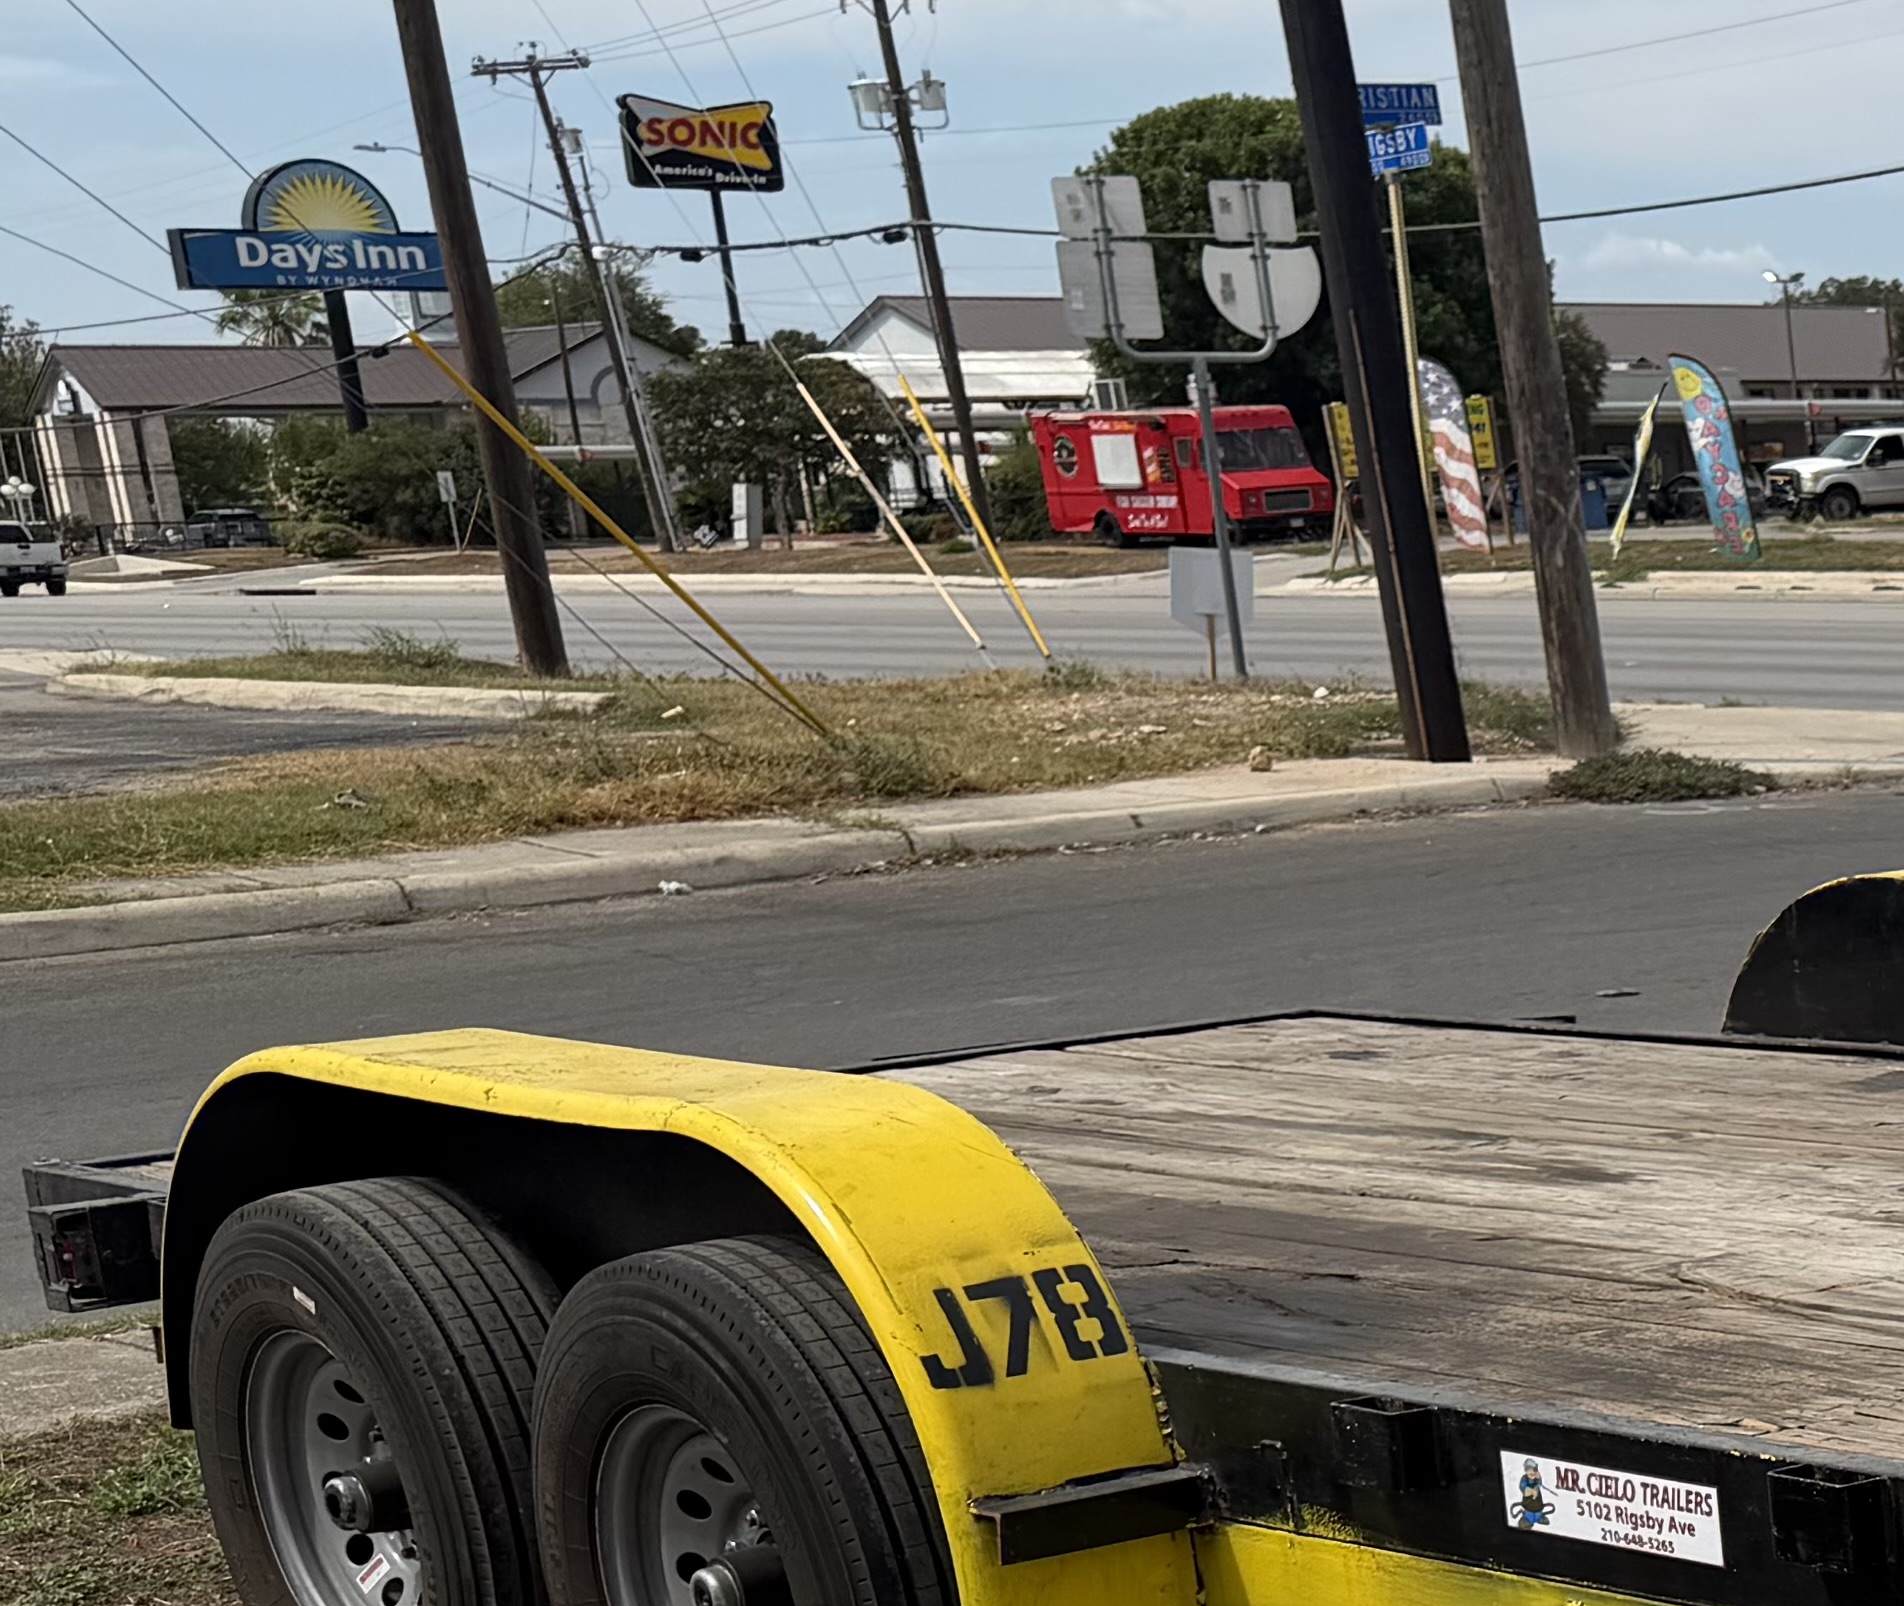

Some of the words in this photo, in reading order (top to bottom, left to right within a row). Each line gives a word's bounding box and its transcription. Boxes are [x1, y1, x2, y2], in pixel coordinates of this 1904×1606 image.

[645, 118, 761, 150] SONIC
[654, 164, 713, 177] America's
[235, 236, 347, 273] Days
[352, 239, 427, 270] Inn
[276, 275, 297, 285] BY
[305, 275, 398, 288] WYNDHAM
[920, 1264, 1128, 1389] J78
[1555, 1466, 1586, 1494] MR.
[1587, 1473, 1636, 1503] CIELO
[1641, 1482, 1713, 1516] TRAILERS
[1576, 1500, 1611, 1521] 5102
[1615, 1505, 1664, 1535] Rigsby
[1668, 1516, 1696, 1537] Ave
